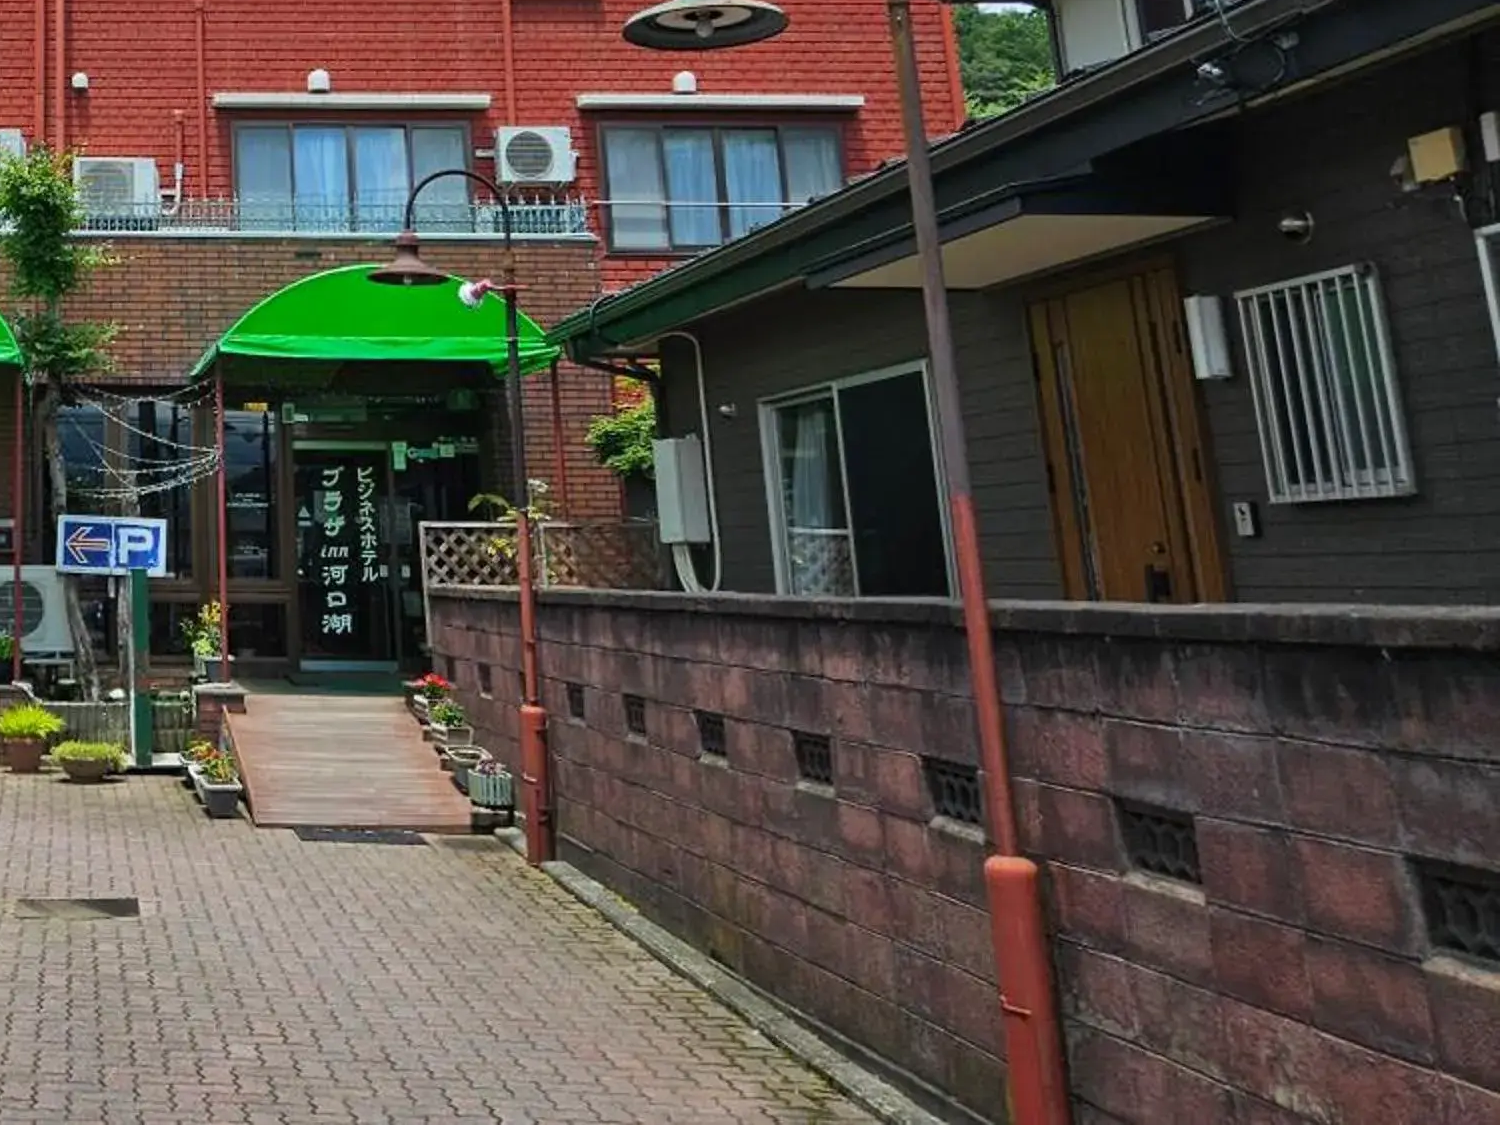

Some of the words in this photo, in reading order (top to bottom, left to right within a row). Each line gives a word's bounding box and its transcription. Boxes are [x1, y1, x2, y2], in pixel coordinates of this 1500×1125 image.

[118, 527, 154, 564] P
[357, 467, 378, 582] ビジネスホテル
